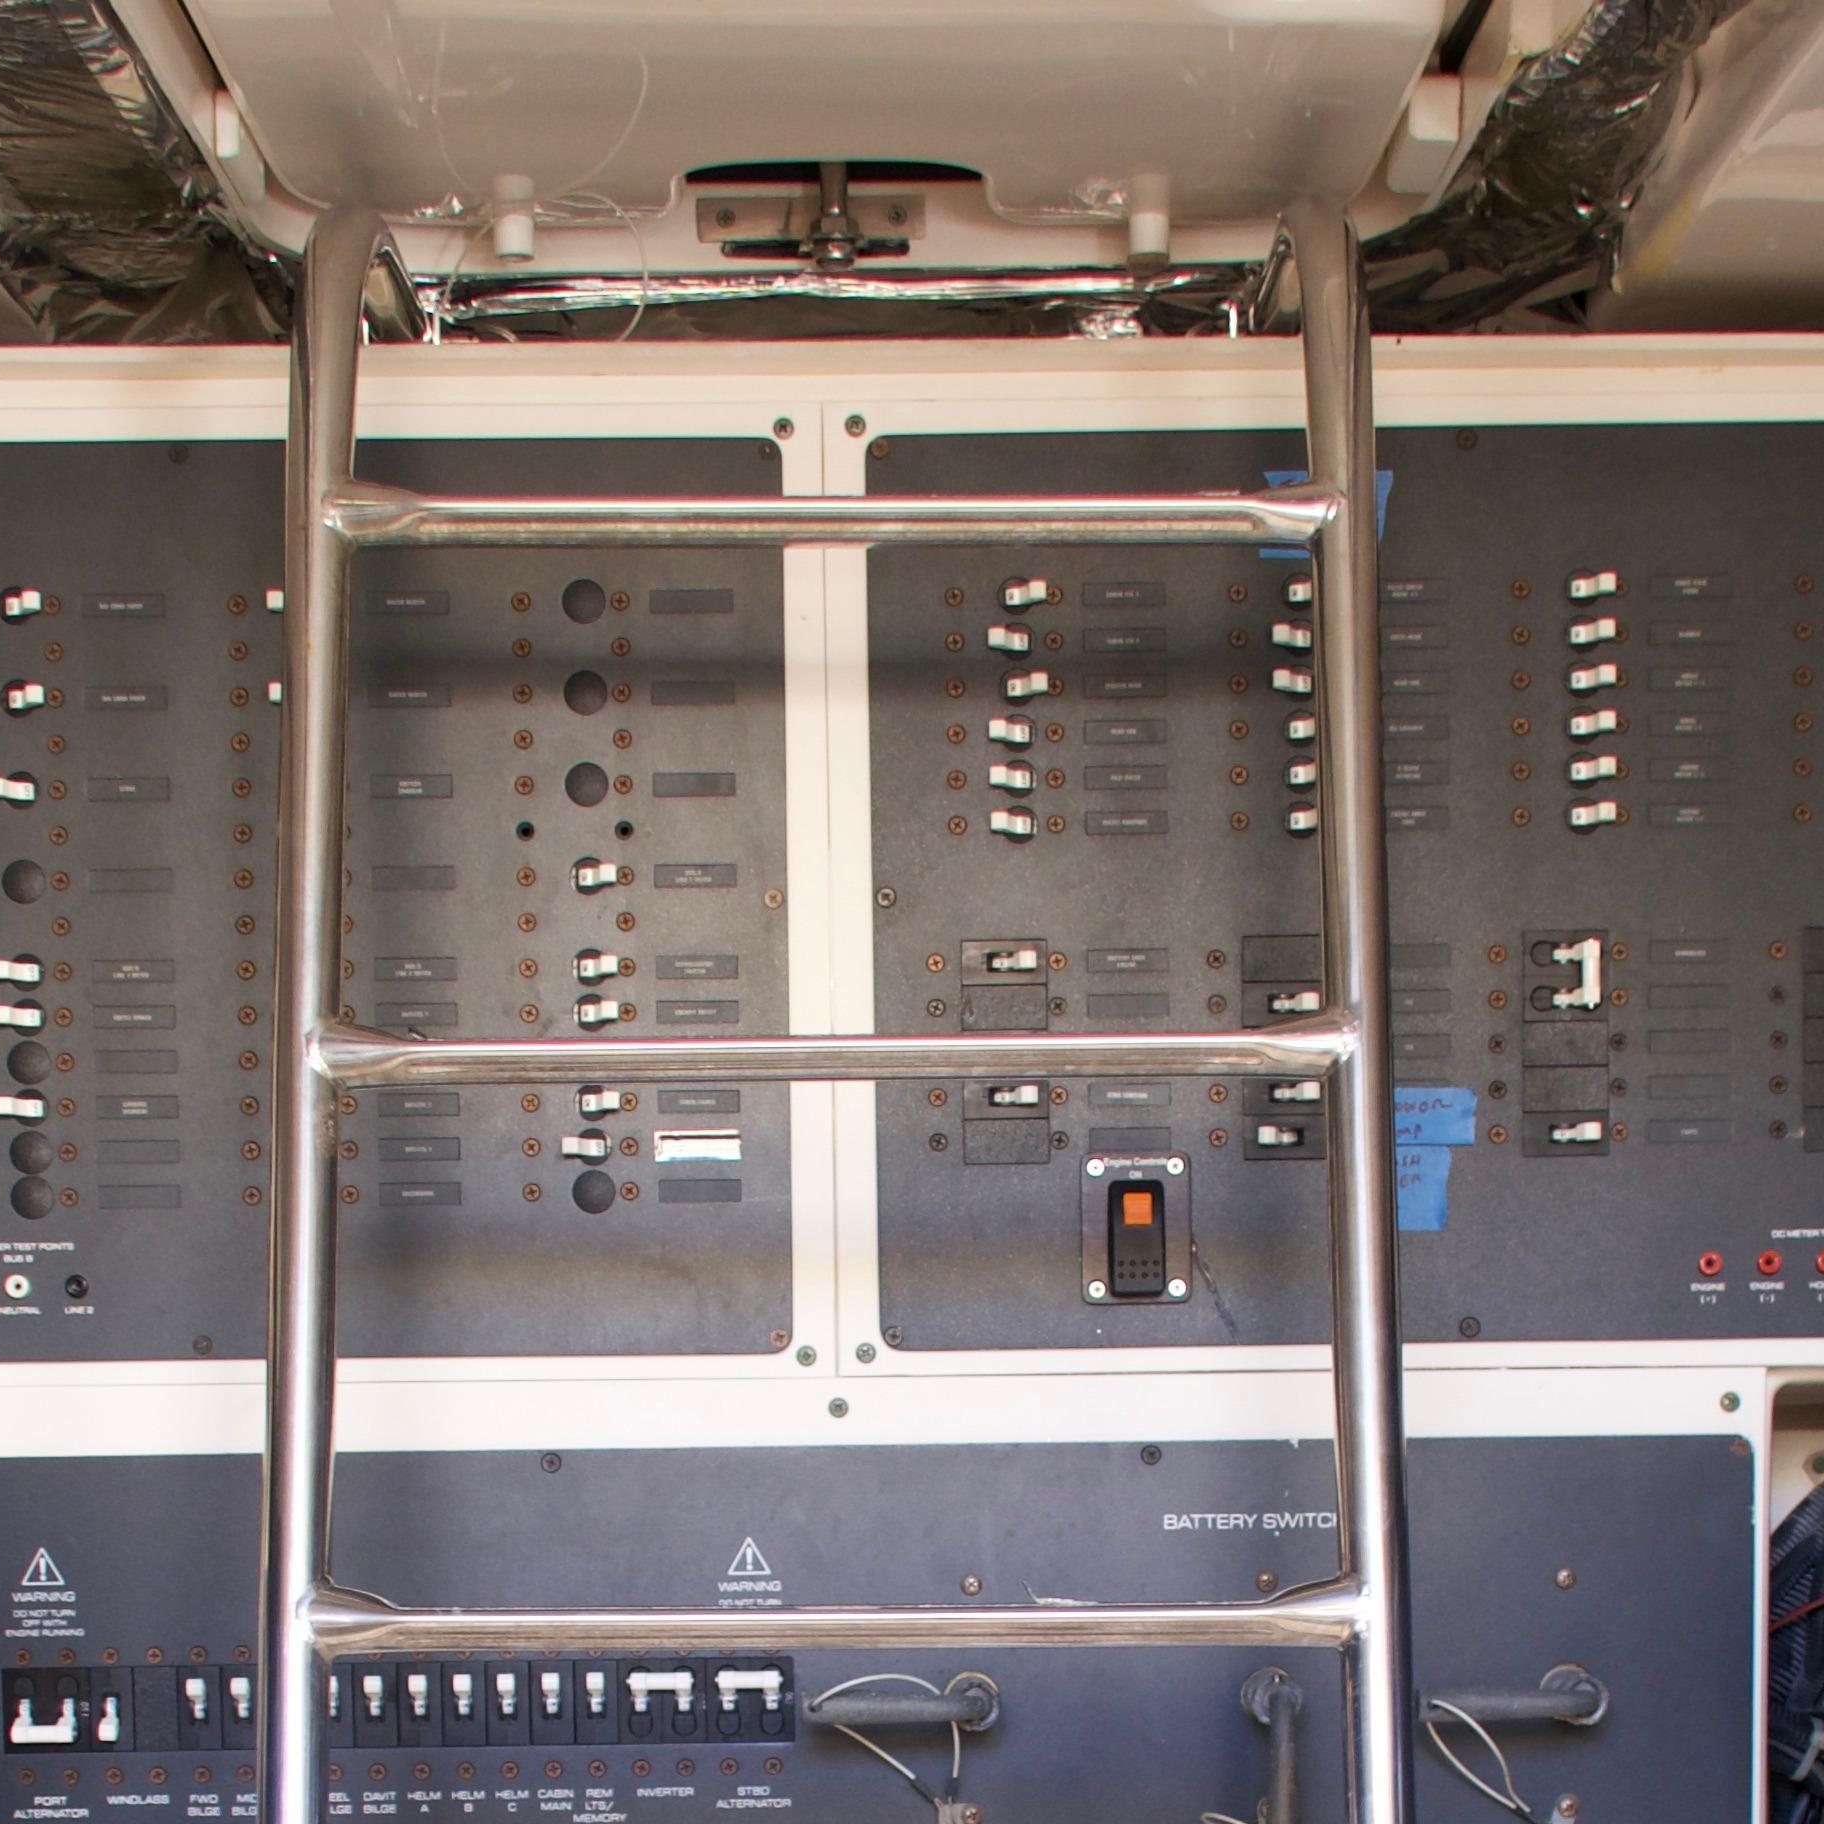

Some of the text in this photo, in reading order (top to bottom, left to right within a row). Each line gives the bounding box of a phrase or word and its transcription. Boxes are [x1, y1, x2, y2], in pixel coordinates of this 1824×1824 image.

[1129, 1170, 1143, 1179] ON
[1771, 1228, 1785, 1238] DC
[1786, 1228, 1817, 1238] METER
[12, 1242, 35, 1250] TEST
[36, 1241, 75, 1250] POINTS
[2, 1254, 24, 1263] BUS
[1690, 1282, 1726, 1292] ENGINE
[1749, 1281, 1785, 1291] ENGINE
[1163, 1513, 1258, 1530] BATTERY
[717, 1580, 782, 1592] WARNING
[10, 1590, 76, 1602] WARNING
[12, 1608, 77, 1618] DO NOT TURN
[22, 1618, 68, 1628] OFF WITH
[4, 1627, 86, 1638] ENGINE RUNNING
[406, 1791, 442, 1801] HELM
[450, 1791, 486, 1801] HELM
[494, 1790, 530, 1800] HELM
[536, 1789, 575, 1800] CABIN
[585, 1788, 614, 1799] REM
[635, 1787, 695, 1798] INVERTER
[737, 1786, 771, 1797] STBD
[33, 1796, 68, 1807] PORT
[106, 1794, 171, 1805] WINDLASS
[189, 1794, 219, 1804] FWD
[328, 1792, 350, 1802] EEL
[362, 1792, 396, 1802] DAVIT
[420, 1804, 431, 1813] A
[463, 1803, 473, 1813] B
[506, 1803, 518, 1813] C
[539, 1801, 573, 1812] MAIN
[715, 1798, 792, 1809] ALTERNATOR
[12, 1808, 90, 1820] ALTERNATOR
[186, 1806, 221, 1817] BILGE
[231, 1806, 257, 1816] BILG
[363, 1804, 397, 1815] BILGE
[572, 1813, 628, 1824] MEMORY
